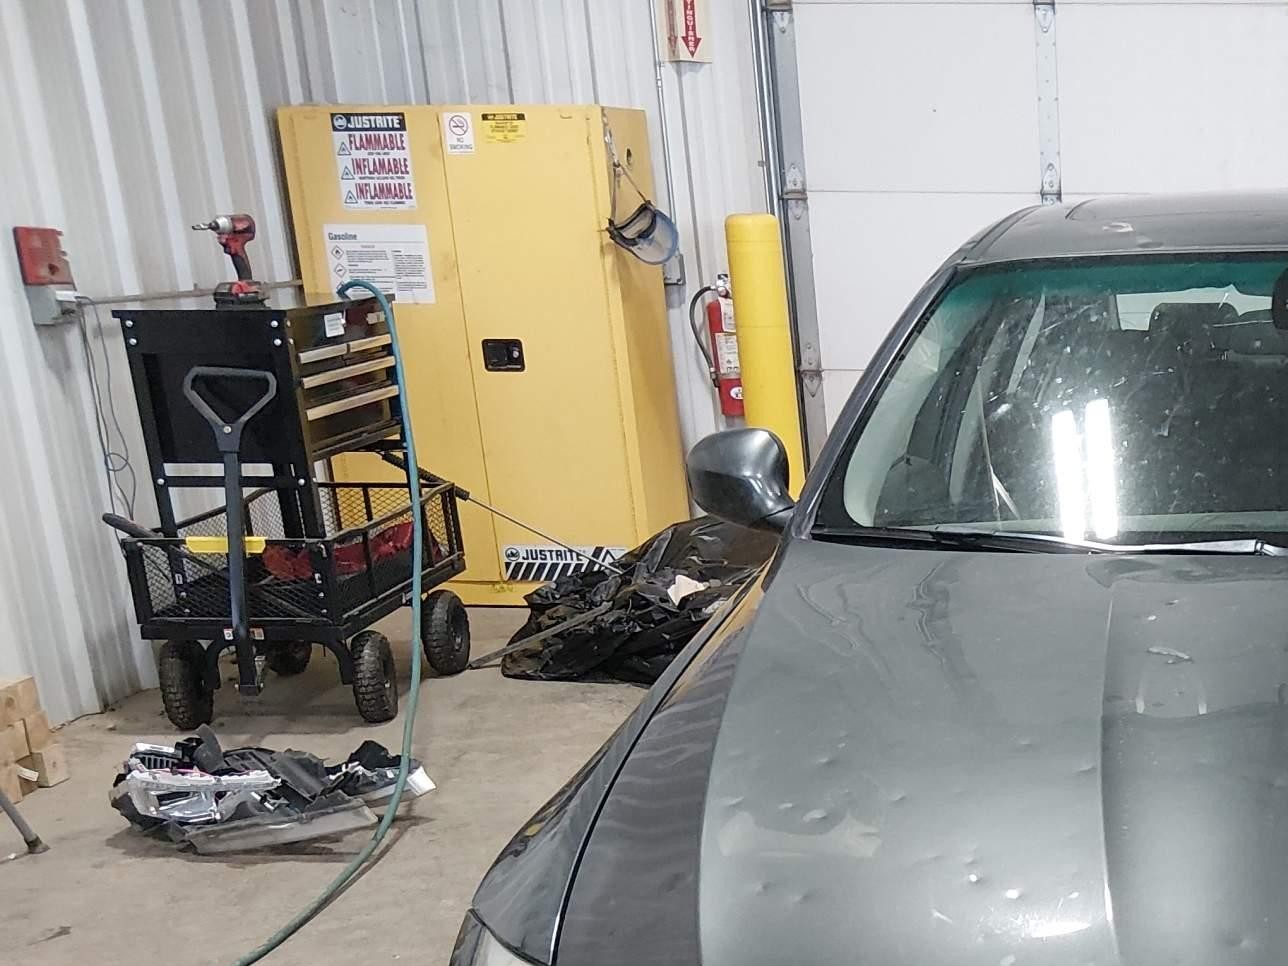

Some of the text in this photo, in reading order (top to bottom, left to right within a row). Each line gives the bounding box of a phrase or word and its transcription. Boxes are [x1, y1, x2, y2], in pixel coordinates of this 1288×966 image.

[347, 115, 401, 129] JUSTRITE
[348, 133, 406, 151] FLAMMABLE
[351, 158, 410, 175] INFLAMABLE
[355, 183, 414, 200] INFLAMMABLE
[328, 232, 358, 240] Gasoline
[522, 549, 585, 561] JUSTRITE
